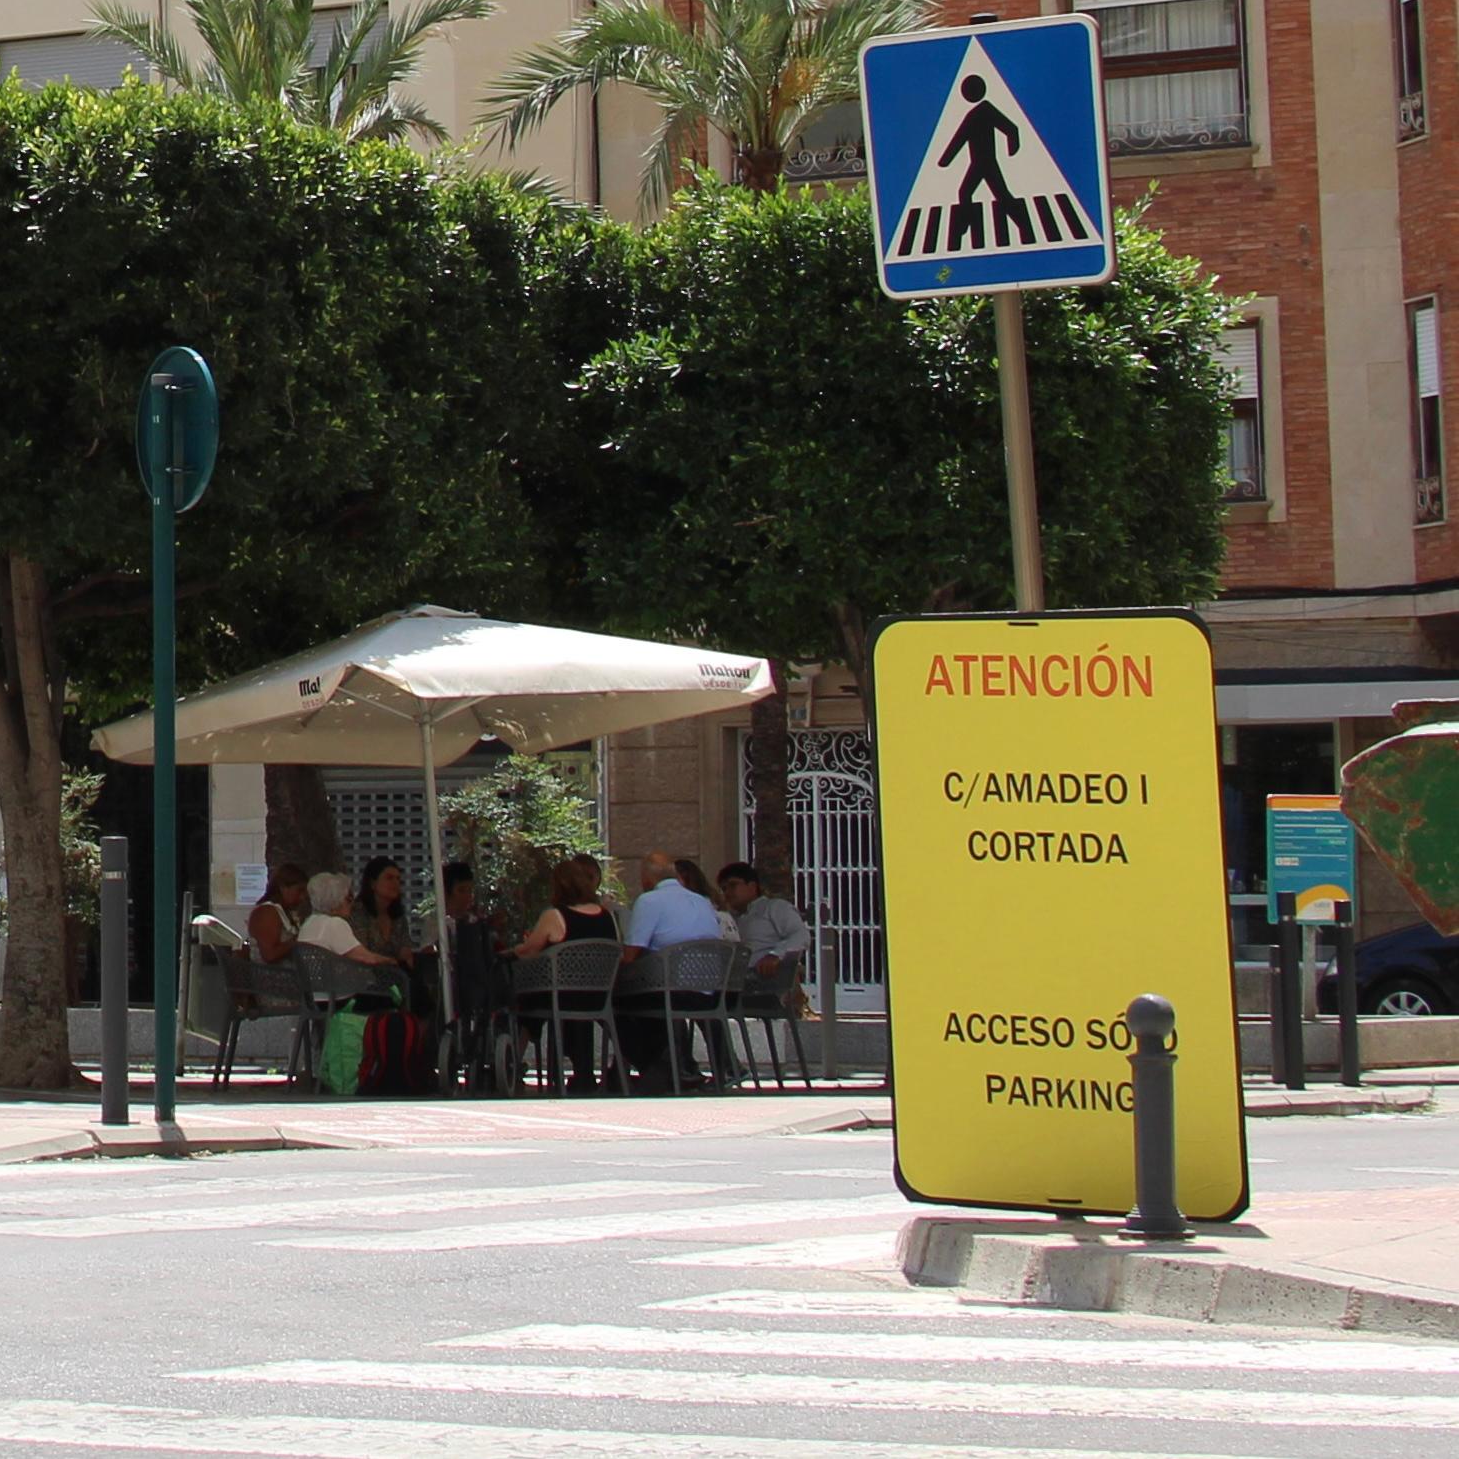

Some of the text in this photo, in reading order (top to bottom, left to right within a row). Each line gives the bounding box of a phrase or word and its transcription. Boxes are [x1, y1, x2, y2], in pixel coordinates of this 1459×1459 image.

[698, 663, 751, 679] Mahou
[925, 643, 1153, 698] ATENCIÓN
[944, 772, 1149, 809] C/AMADEO I
[968, 830, 1129, 864] CORTADA
[943, 1011, 1179, 1053] ACCESO SÓ
[985, 1074, 1135, 1113] PARKING
